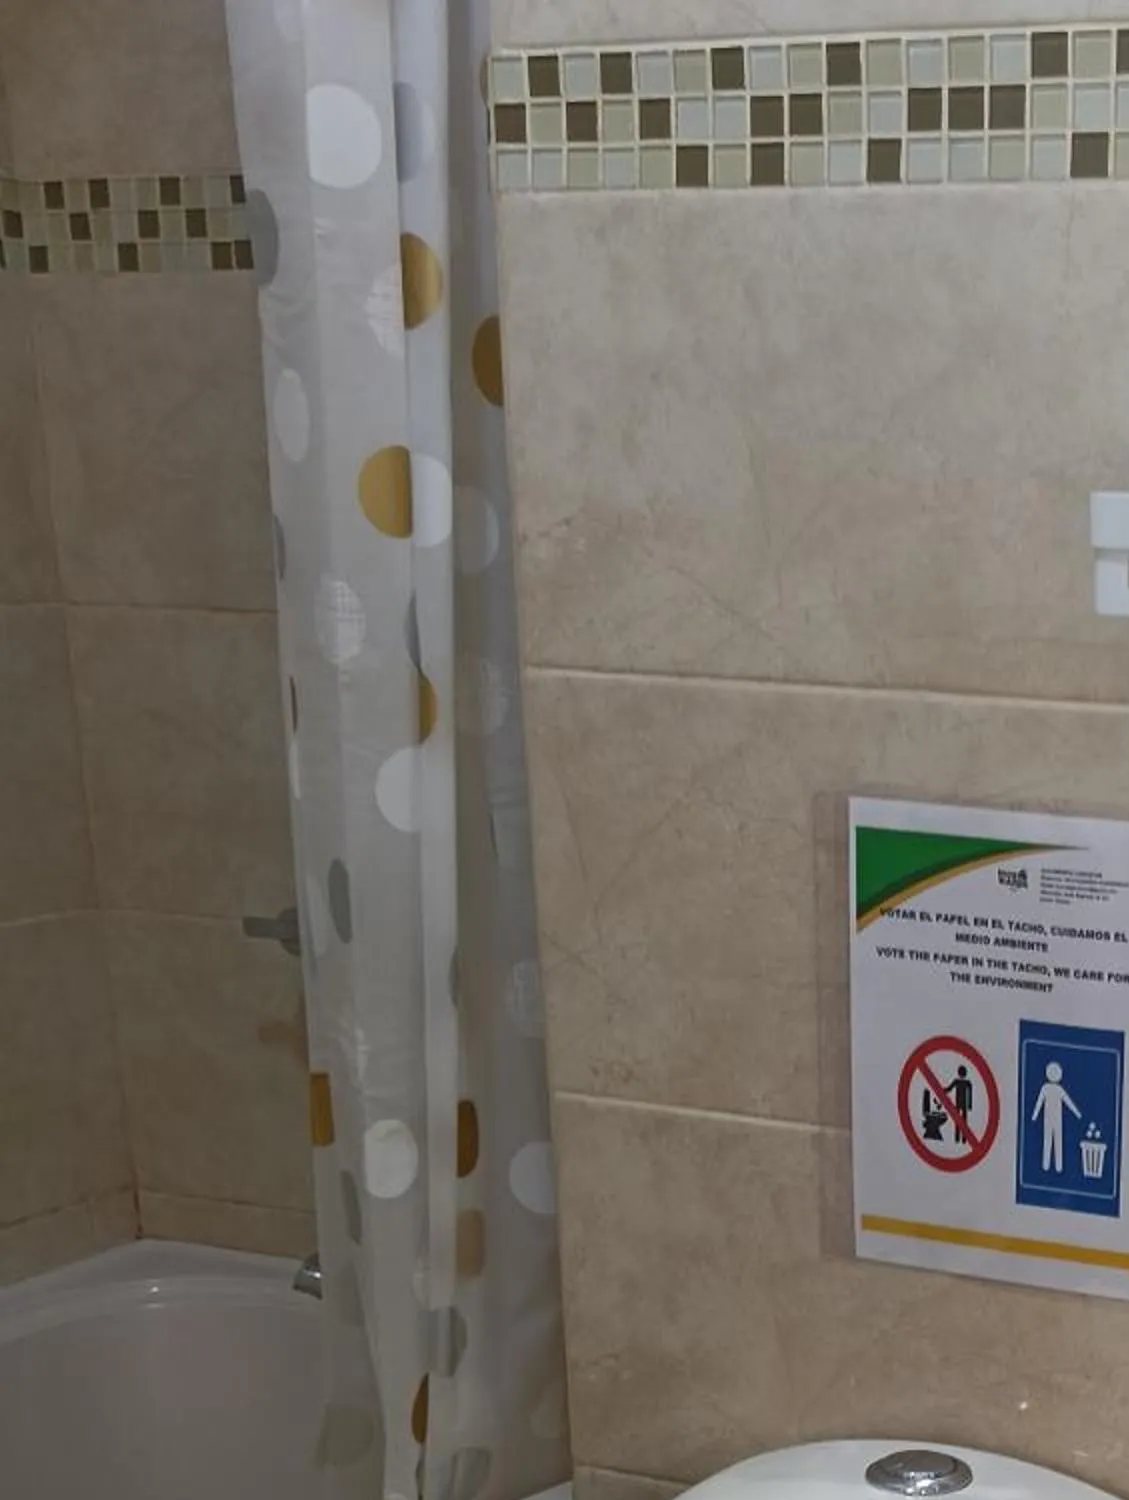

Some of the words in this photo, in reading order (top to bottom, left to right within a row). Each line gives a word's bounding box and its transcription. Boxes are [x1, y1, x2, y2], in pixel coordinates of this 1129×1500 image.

[919, 911, 933, 922] EL
[935, 913, 970, 926] PAPEL
[973, 917, 989, 928] EN
[991, 919, 1004, 930] EL
[1050, 926, 1111, 941] CUIDAMOS
[1113, 932, 1128, 943] EL
[955, 932, 991, 945] MEDIO
[993, 936, 1049, 952] AMBIENTE
[876, 947, 905, 959] VOTE
[908, 949, 931, 961] THE
[933, 952, 969, 965] PAPER
[971, 957, 984, 968] IN
[987, 959, 1009, 970] THE
[1054, 967, 1071, 978] WE
[1073, 969, 1104, 981] CARE
[950, 971, 972, 983] THE
[974, 974, 1053, 992] ENVIRONMENT
